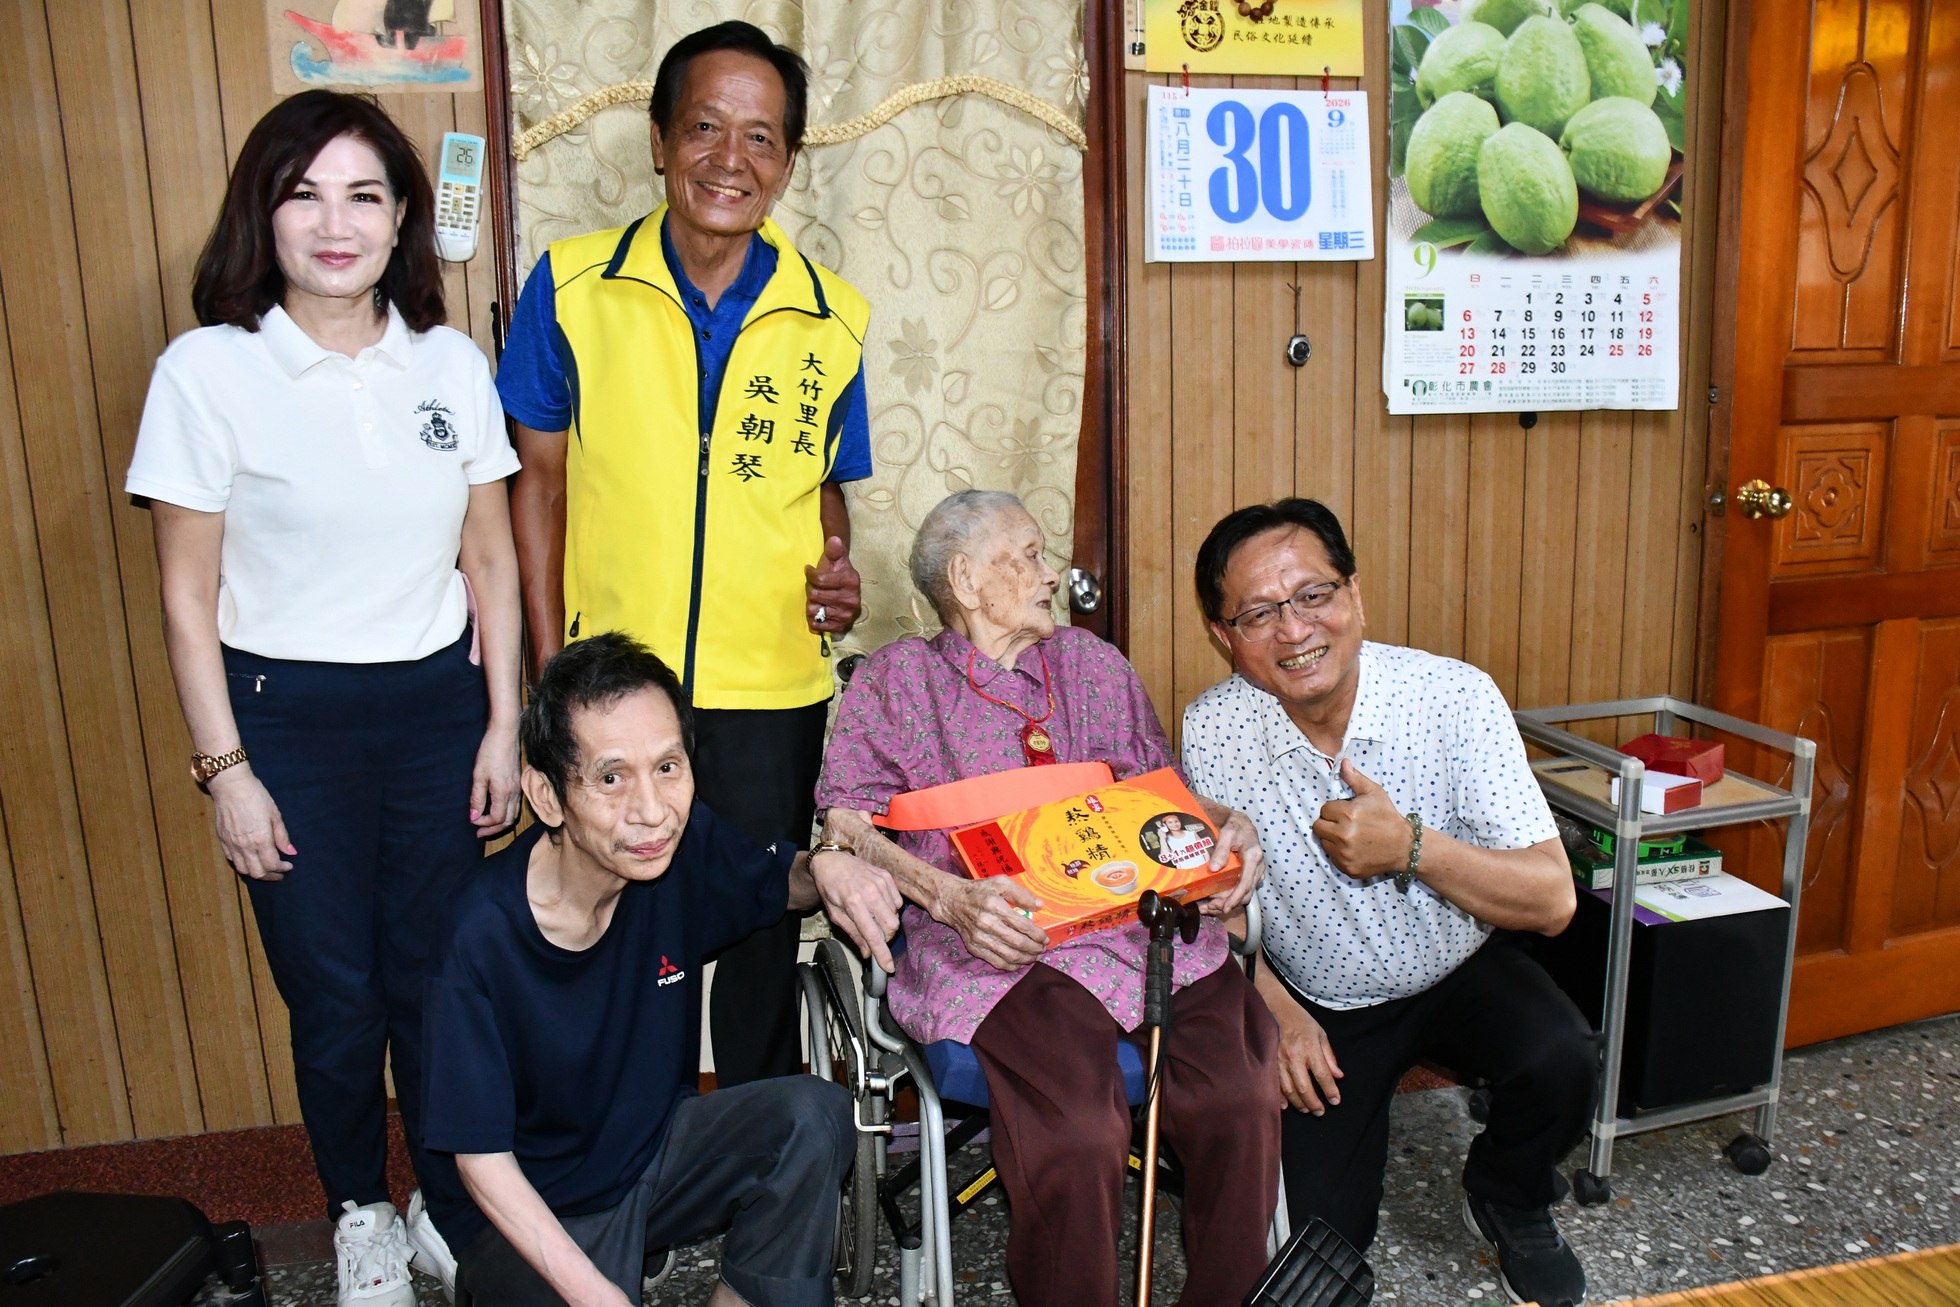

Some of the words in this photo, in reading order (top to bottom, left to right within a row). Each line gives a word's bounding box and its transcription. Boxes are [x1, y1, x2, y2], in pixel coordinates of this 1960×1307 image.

[1325, 99, 1351, 107] 2026
[1328, 110, 1345, 128] 9
[457, 148, 473, 164] 26
[1206, 100, 1312, 224] 30
[1176, 121, 1192, 207] 八月二十日
[1319, 231, 1365, 250] 星期三
[1413, 242, 1437, 280] 9
[1471, 274, 1480, 282] 日
[1531, 275, 1542, 283] 二
[1561, 275, 1572, 284] 三
[1591, 275, 1601, 284] 四
[1620, 275, 1630, 284] 五
[1649, 276, 1659, 284] 六
[1526, 293, 1532, 304] 1
[1556, 293, 1563, 304] 2
[1585, 293, 1592, 304] 3
[1614, 294, 1621, 304] 4
[1643, 294, 1650, 305] 5
[1463, 310, 1471, 321] 6
[1494, 310, 1502, 322] 7
[1525, 310, 1532, 321] 8
[1555, 311, 1562, 321] 9
[1582, 311, 1595, 322] 10
[1611, 311, 1623, 322] 11
[1640, 311, 1652, 322] 12
[1461, 328, 1474, 339] 13
[1492, 328, 1506, 339] 14
[1522, 328, 1535, 339] 15
[1552, 328, 1564, 339] 16
[1581, 328, 1594, 339] 17
[1611, 328, 1623, 339] 18
[1639, 328, 1652, 339] 19
[1460, 345, 1475, 356] 20
[1492, 345, 1504, 356] 21
[1522, 345, 1535, 356] 22
[1551, 345, 1564, 356] 23
[1581, 345, 1594, 356] 24
[1610, 345, 1623, 356] 25
[1638, 345, 1652, 356] 26
[1460, 362, 1474, 374] 27
[1491, 362, 1505, 373] 28
[1522, 362, 1535, 373] 29
[1551, 362, 1565, 373] 30
[1428, 380, 1493, 392] 彰化市農會
[790, 352, 828, 456] 大竹里長
[728, 376, 780, 482] 吳朝琴
[657, 971, 685, 987] FUSO
[349, 1220, 365, 1228] FILA
